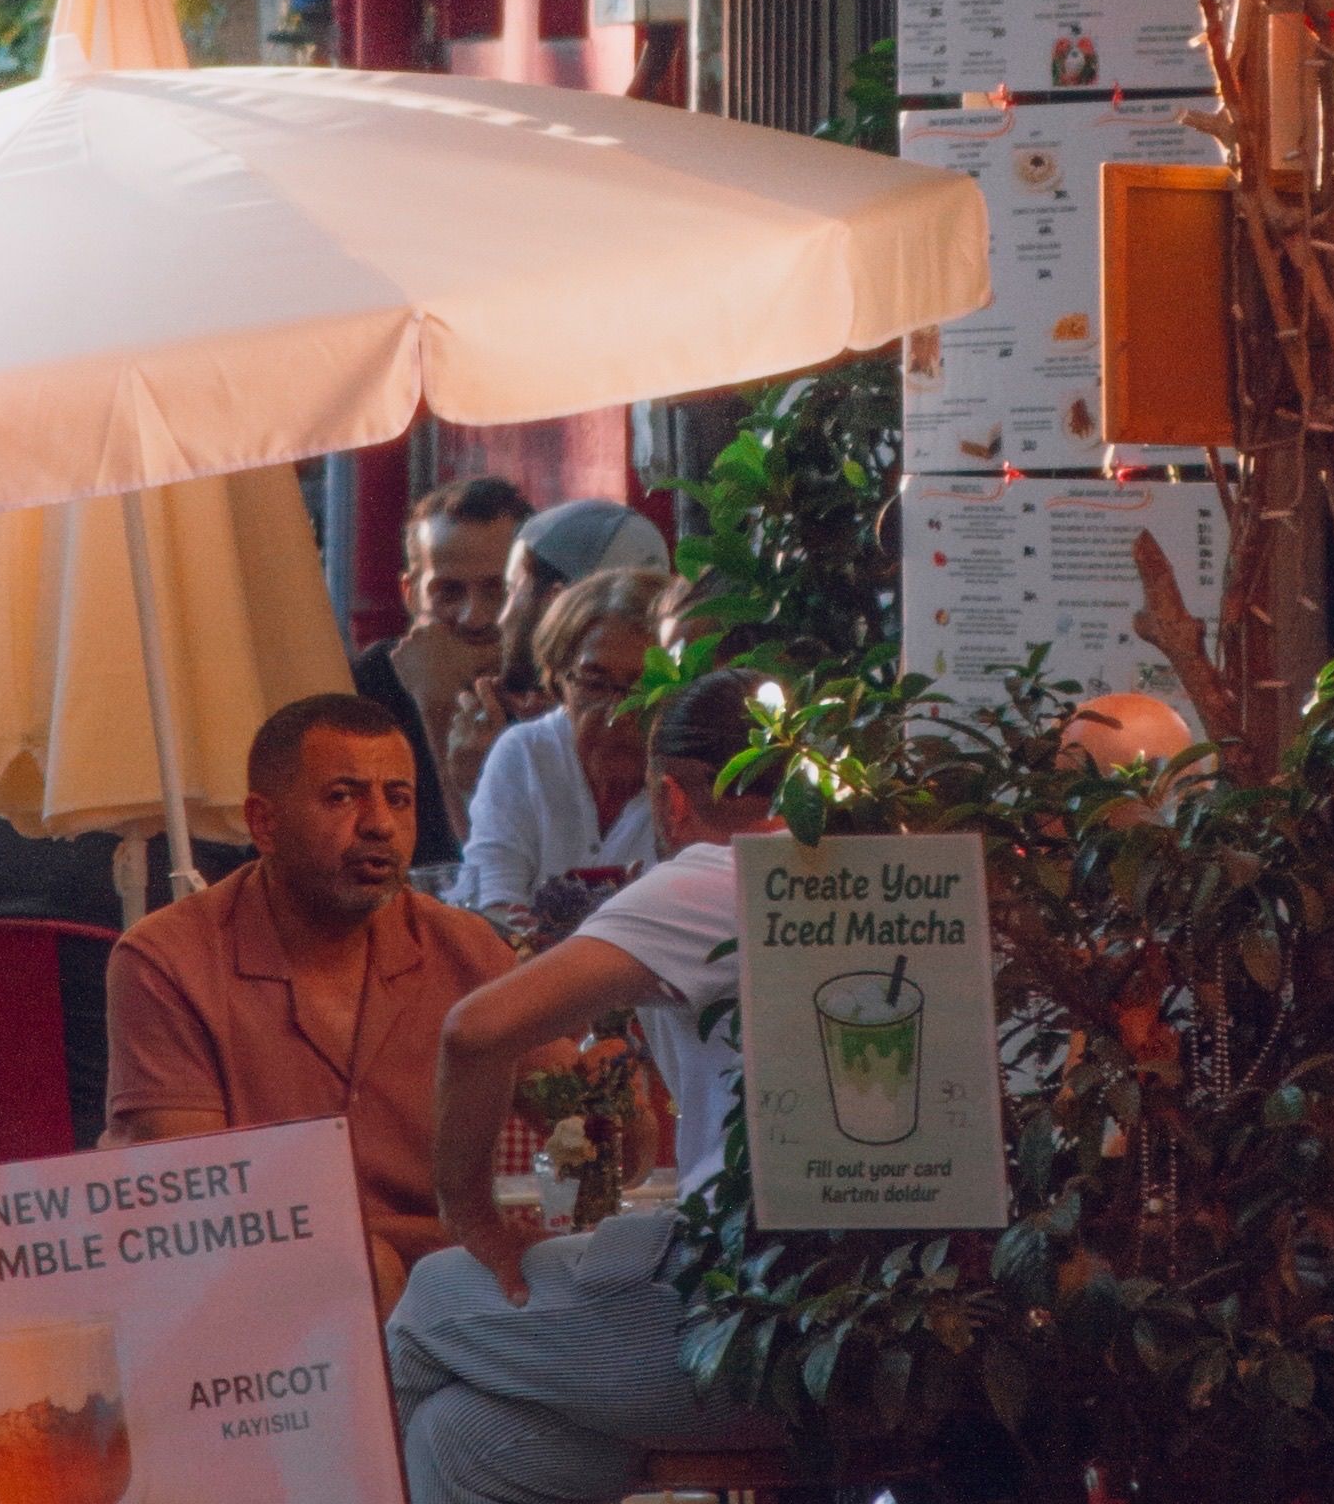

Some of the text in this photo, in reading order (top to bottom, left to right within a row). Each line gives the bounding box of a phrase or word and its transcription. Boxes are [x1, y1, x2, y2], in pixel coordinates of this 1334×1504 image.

[765, 863, 959, 903] Create Your
[763, 909, 966, 948] Iced Matcha
[87, 1160, 253, 1215] DESSERT
[805, 1158, 953, 1183] Fill out your card
[883, 1182, 942, 1202] doldur
[117, 1204, 315, 1264] CRUMBLE
[188, 1361, 333, 1411] APRICOT
